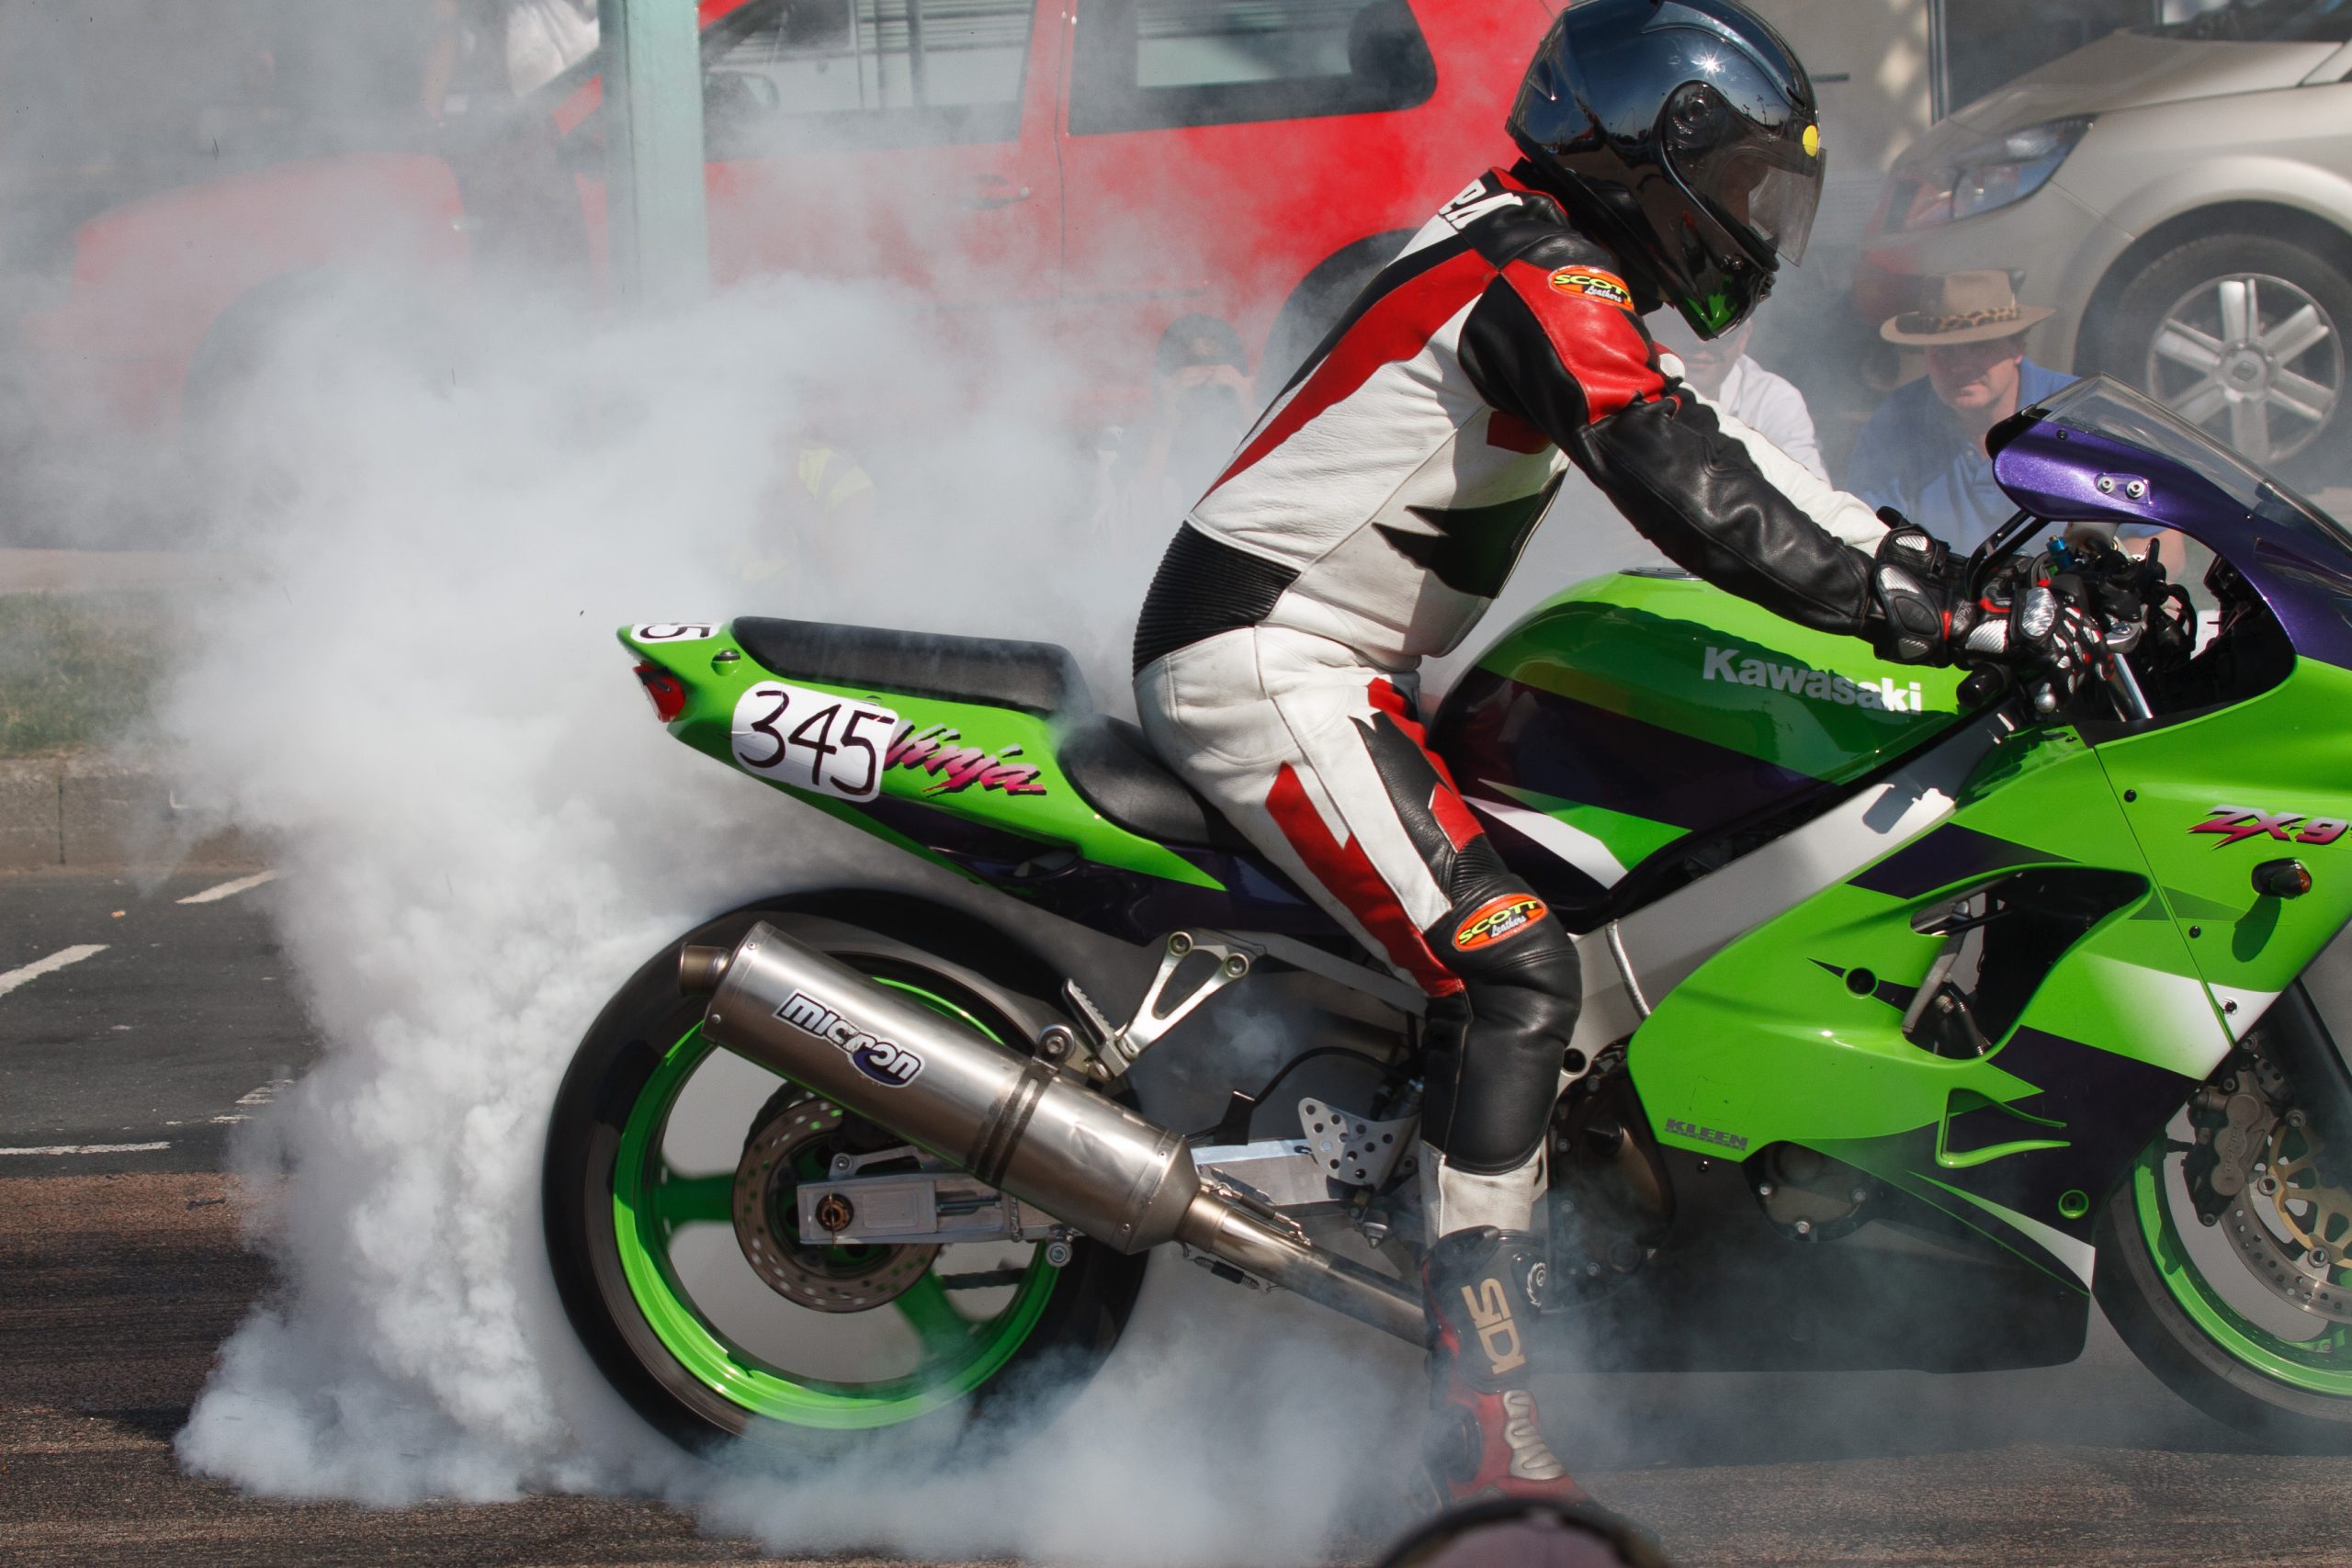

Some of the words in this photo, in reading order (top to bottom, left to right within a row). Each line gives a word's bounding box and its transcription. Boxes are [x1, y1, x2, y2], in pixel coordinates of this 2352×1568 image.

[1702, 646, 1923, 715] Kawasaki
[738, 690, 896, 796] 345
[2186, 805, 2352, 851] ZX-9
[1458, 900, 1537, 944] SCOTT
[1490, 915, 1527, 938] Leathers
[777, 992, 922, 1082] micron
[1666, 1118, 1748, 1149] KLEEN
[1461, 1278, 1526, 1375] SIDI
